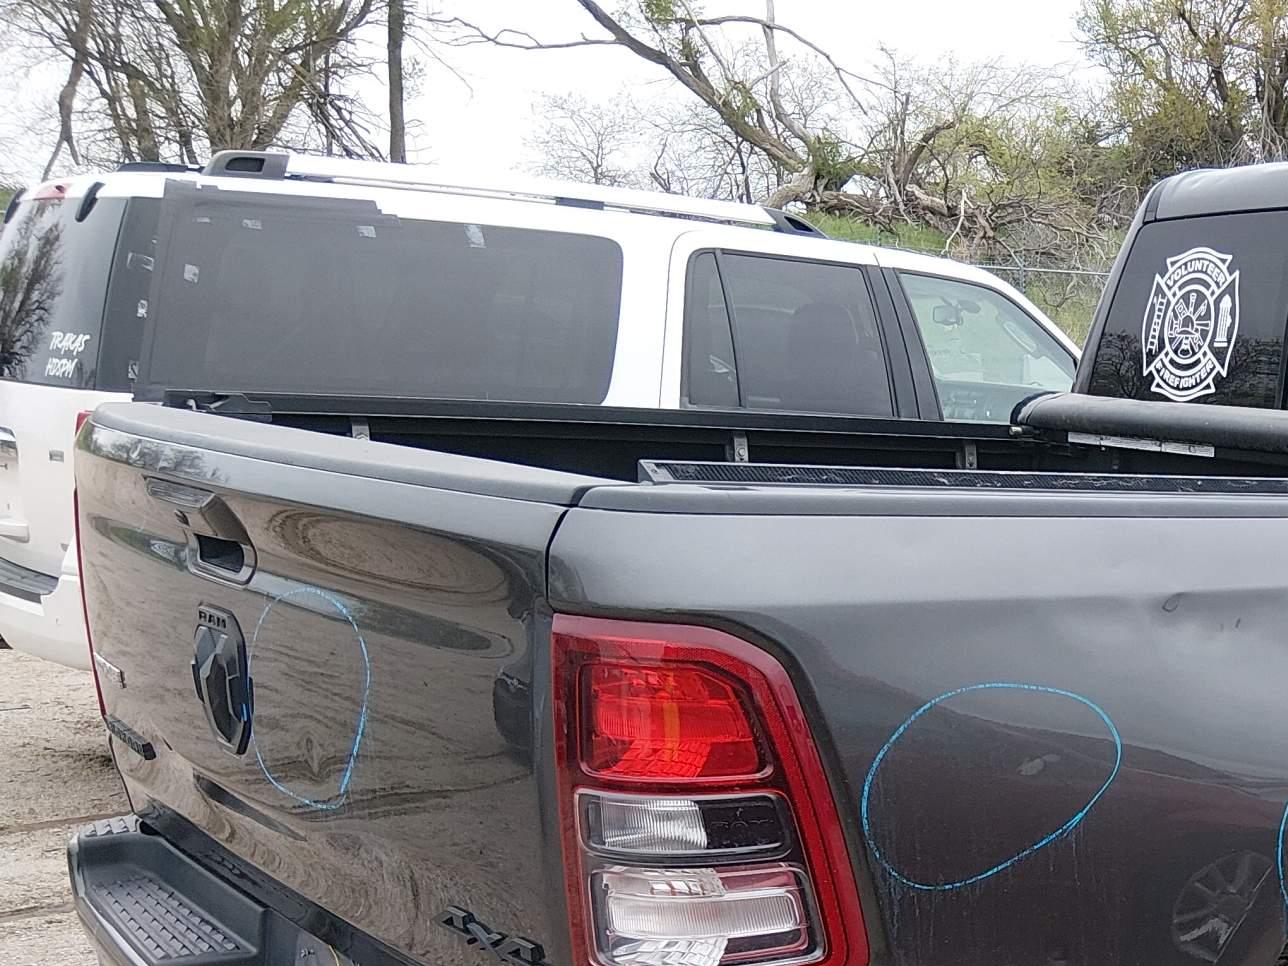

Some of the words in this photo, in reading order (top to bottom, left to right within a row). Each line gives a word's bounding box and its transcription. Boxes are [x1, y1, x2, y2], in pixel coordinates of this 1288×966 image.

[1166, 260, 1228, 288] VOLUNTEER
[1154, 359, 1215, 389] FIREFIGHTER
[198, 610, 227, 629] RAM
